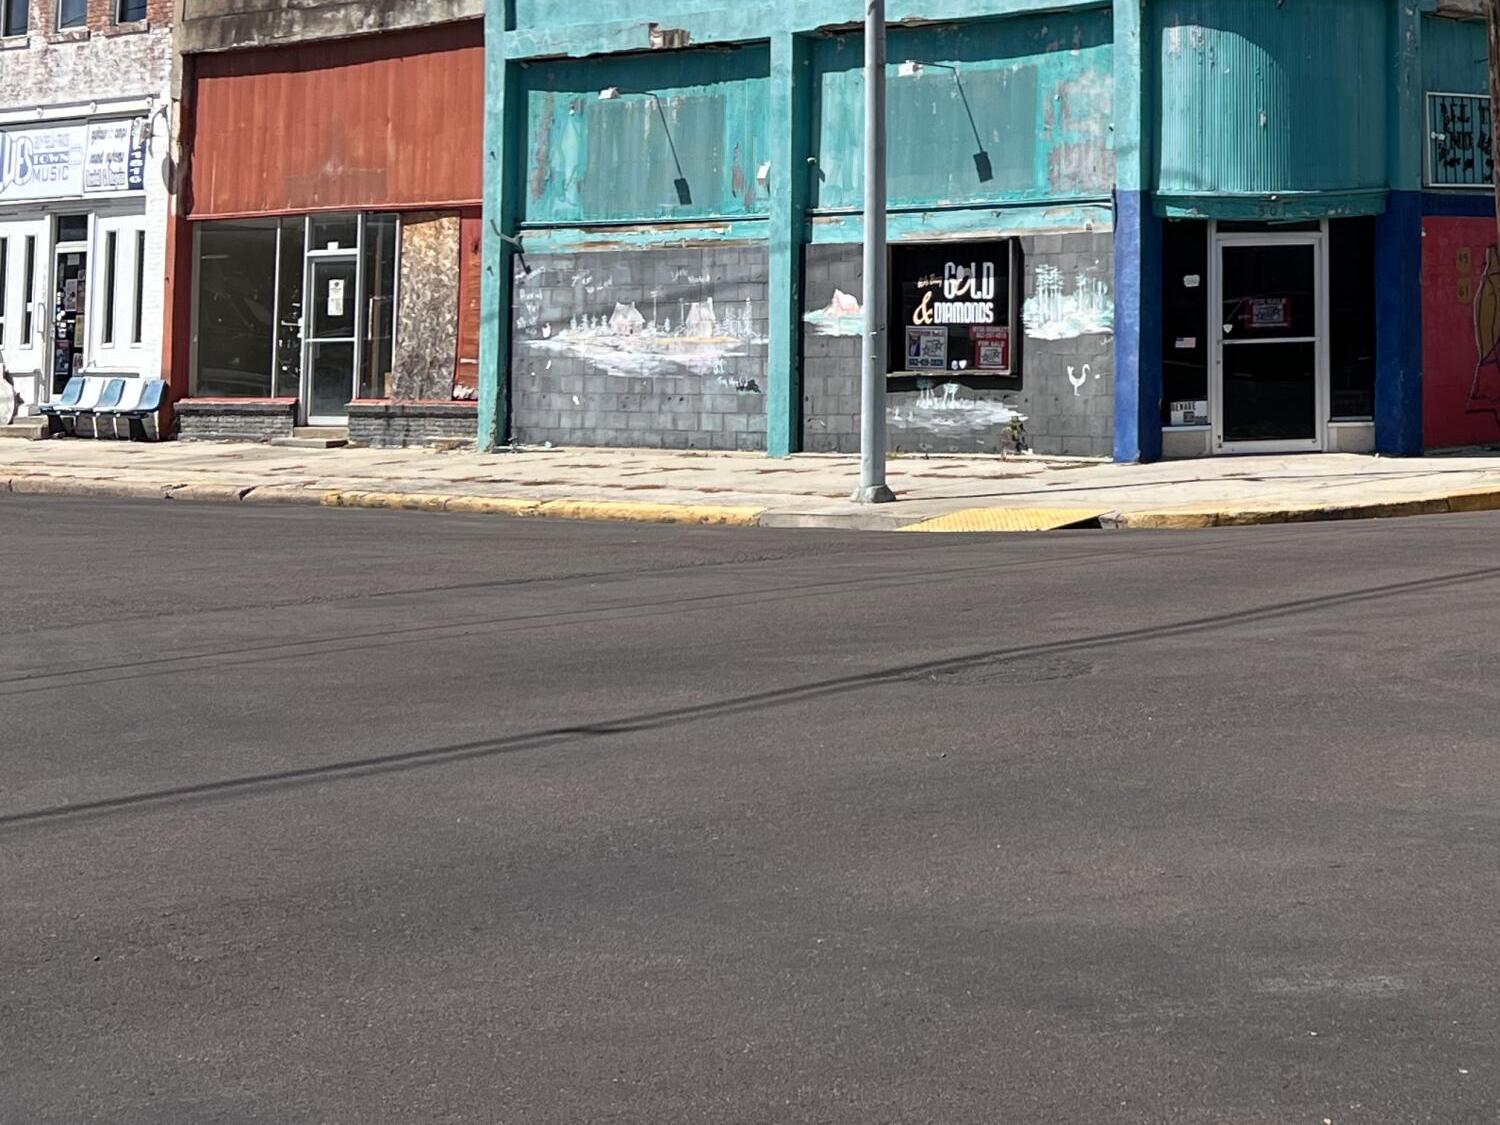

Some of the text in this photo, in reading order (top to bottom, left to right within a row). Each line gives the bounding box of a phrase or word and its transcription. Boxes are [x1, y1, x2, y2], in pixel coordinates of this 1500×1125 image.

[32, 165, 69, 182] MUSIC
[944, 261, 995, 299] GOLD
[912, 291, 994, 325] & DIAMONDS
